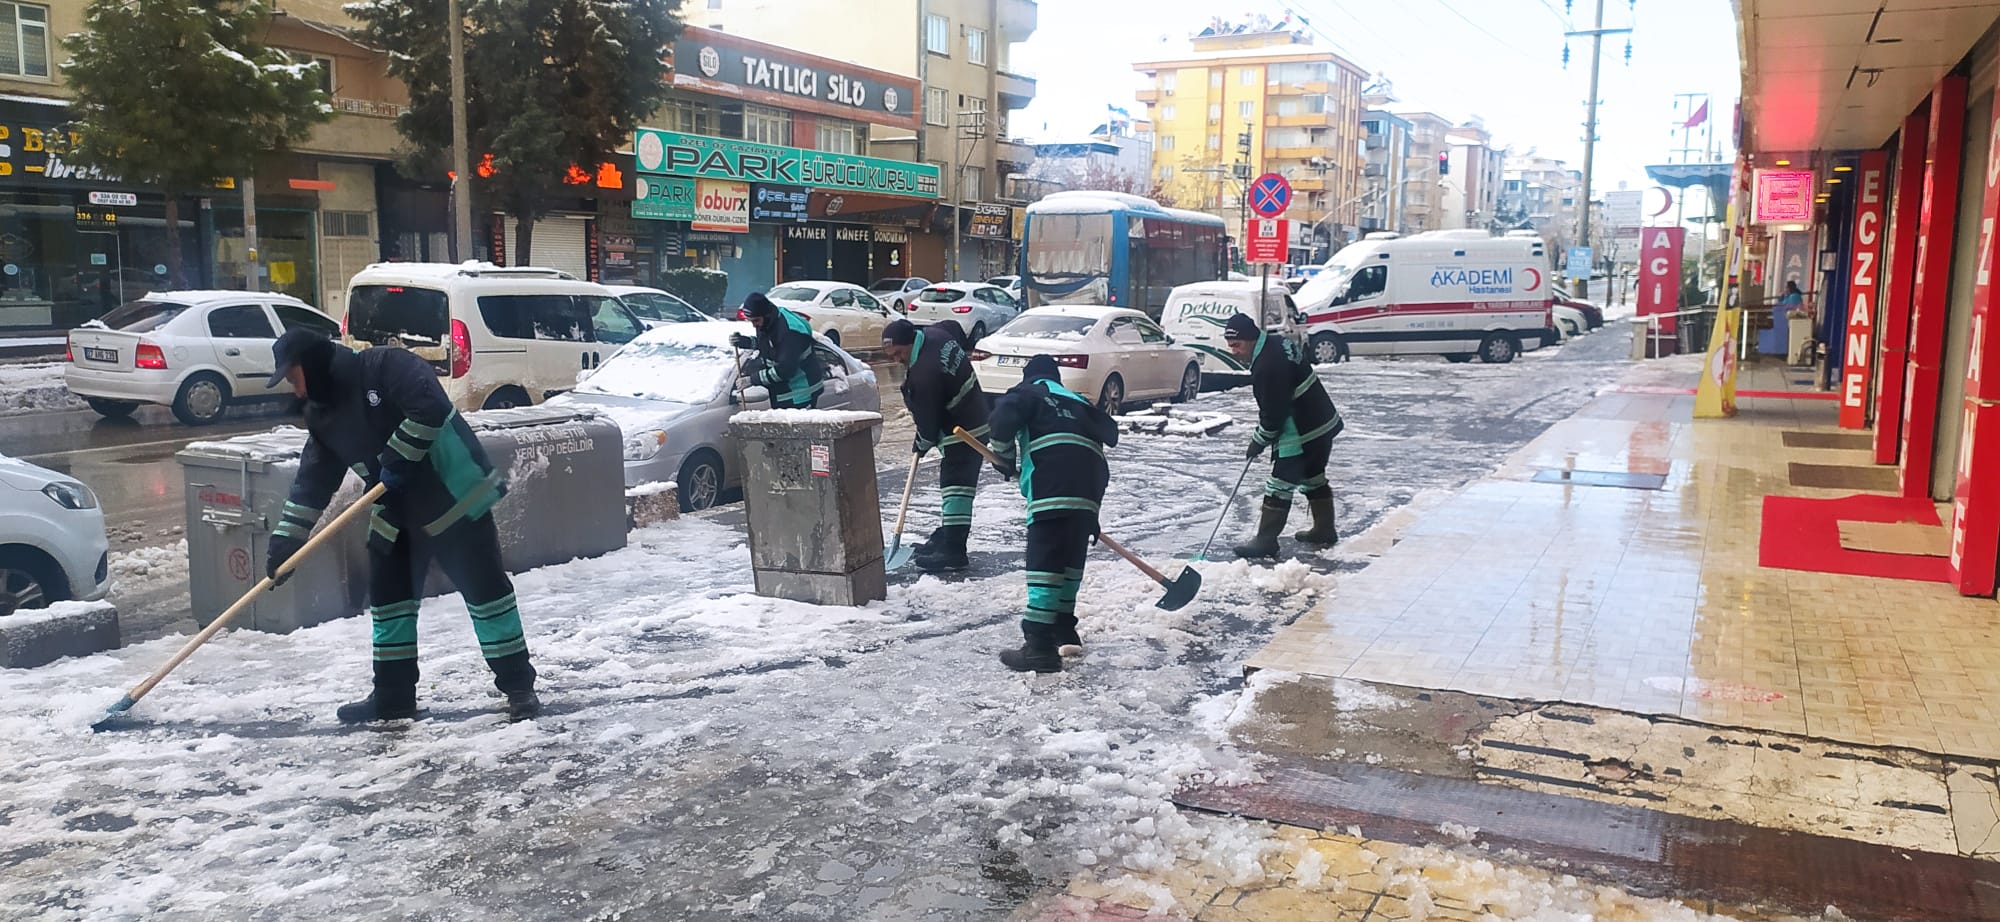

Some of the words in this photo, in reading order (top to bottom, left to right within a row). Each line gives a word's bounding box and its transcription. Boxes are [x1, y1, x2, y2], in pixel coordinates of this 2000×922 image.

[743, 55, 817, 98] TATLICI
[666, 144, 799, 183] PARK
[802, 156, 867, 187] SÜRÜCÜ
[868, 166, 916, 192] KURSU
[650, 183, 693, 202] PARK
[703, 188, 747, 211] oburx
[788, 226, 826, 240] KATMER
[1430, 267, 1512, 288] AKADEMİ
[1469, 285, 1512, 294] Hastanesi
[1845, 170, 1880, 407] ECZANE
[556, 437, 594, 455] DEĞİLDİR
